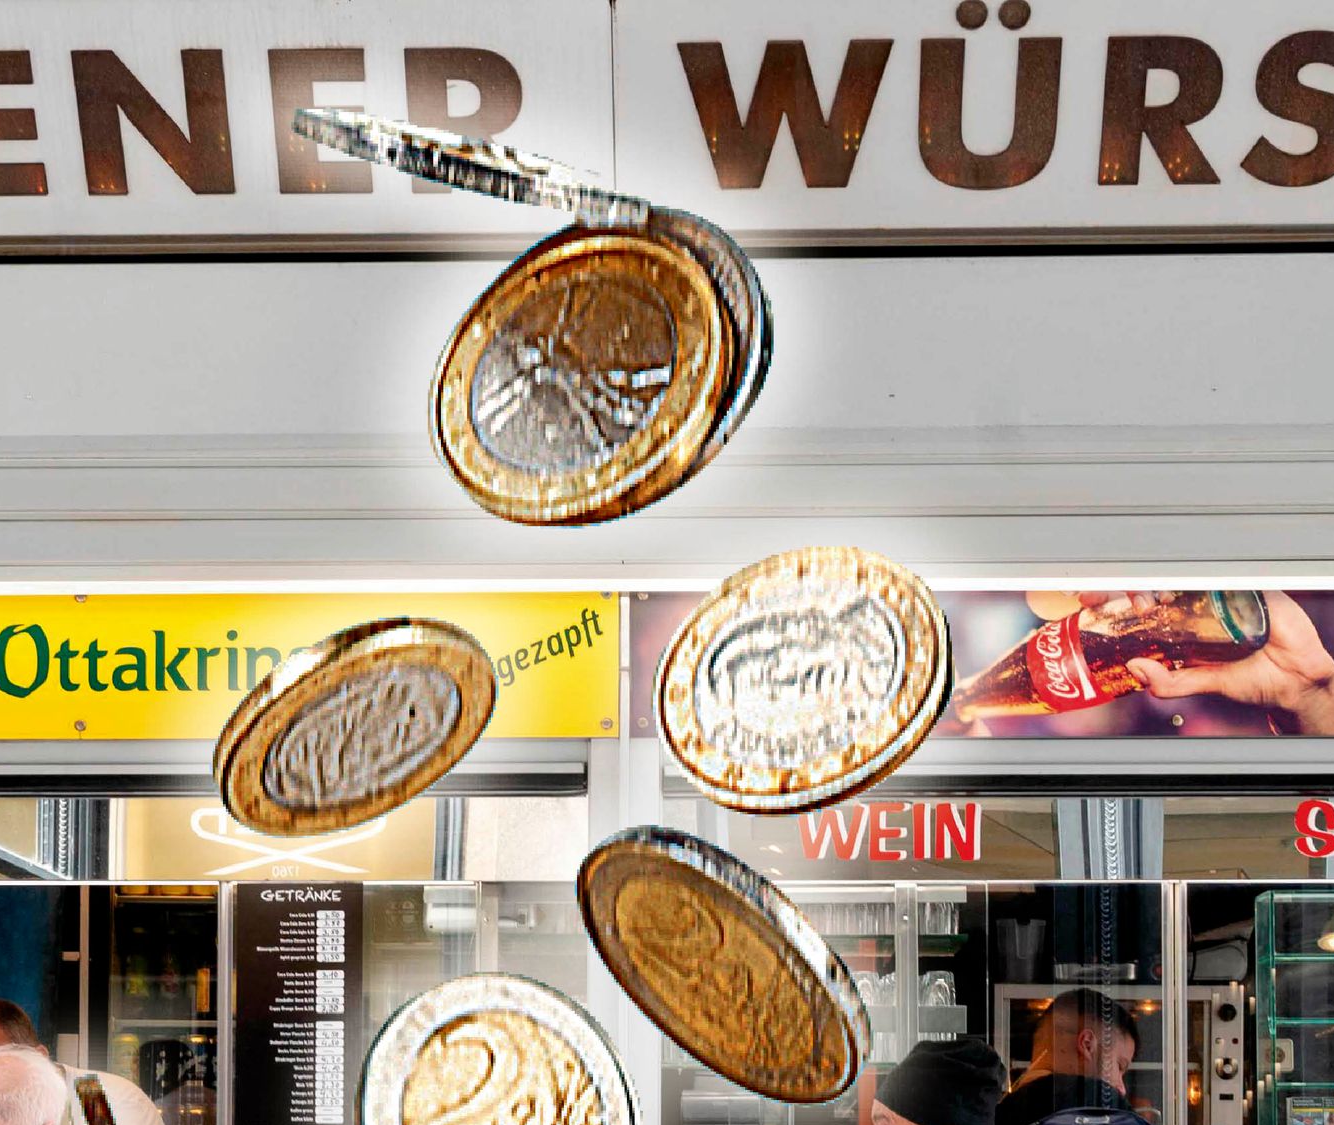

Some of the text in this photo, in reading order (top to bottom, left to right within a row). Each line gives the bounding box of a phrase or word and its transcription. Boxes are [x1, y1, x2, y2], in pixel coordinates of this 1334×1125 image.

[497, 608, 603, 687] gezapft
[797, 801, 982, 862] WEIN
[260, 886, 342, 902] GETRÄNKE
